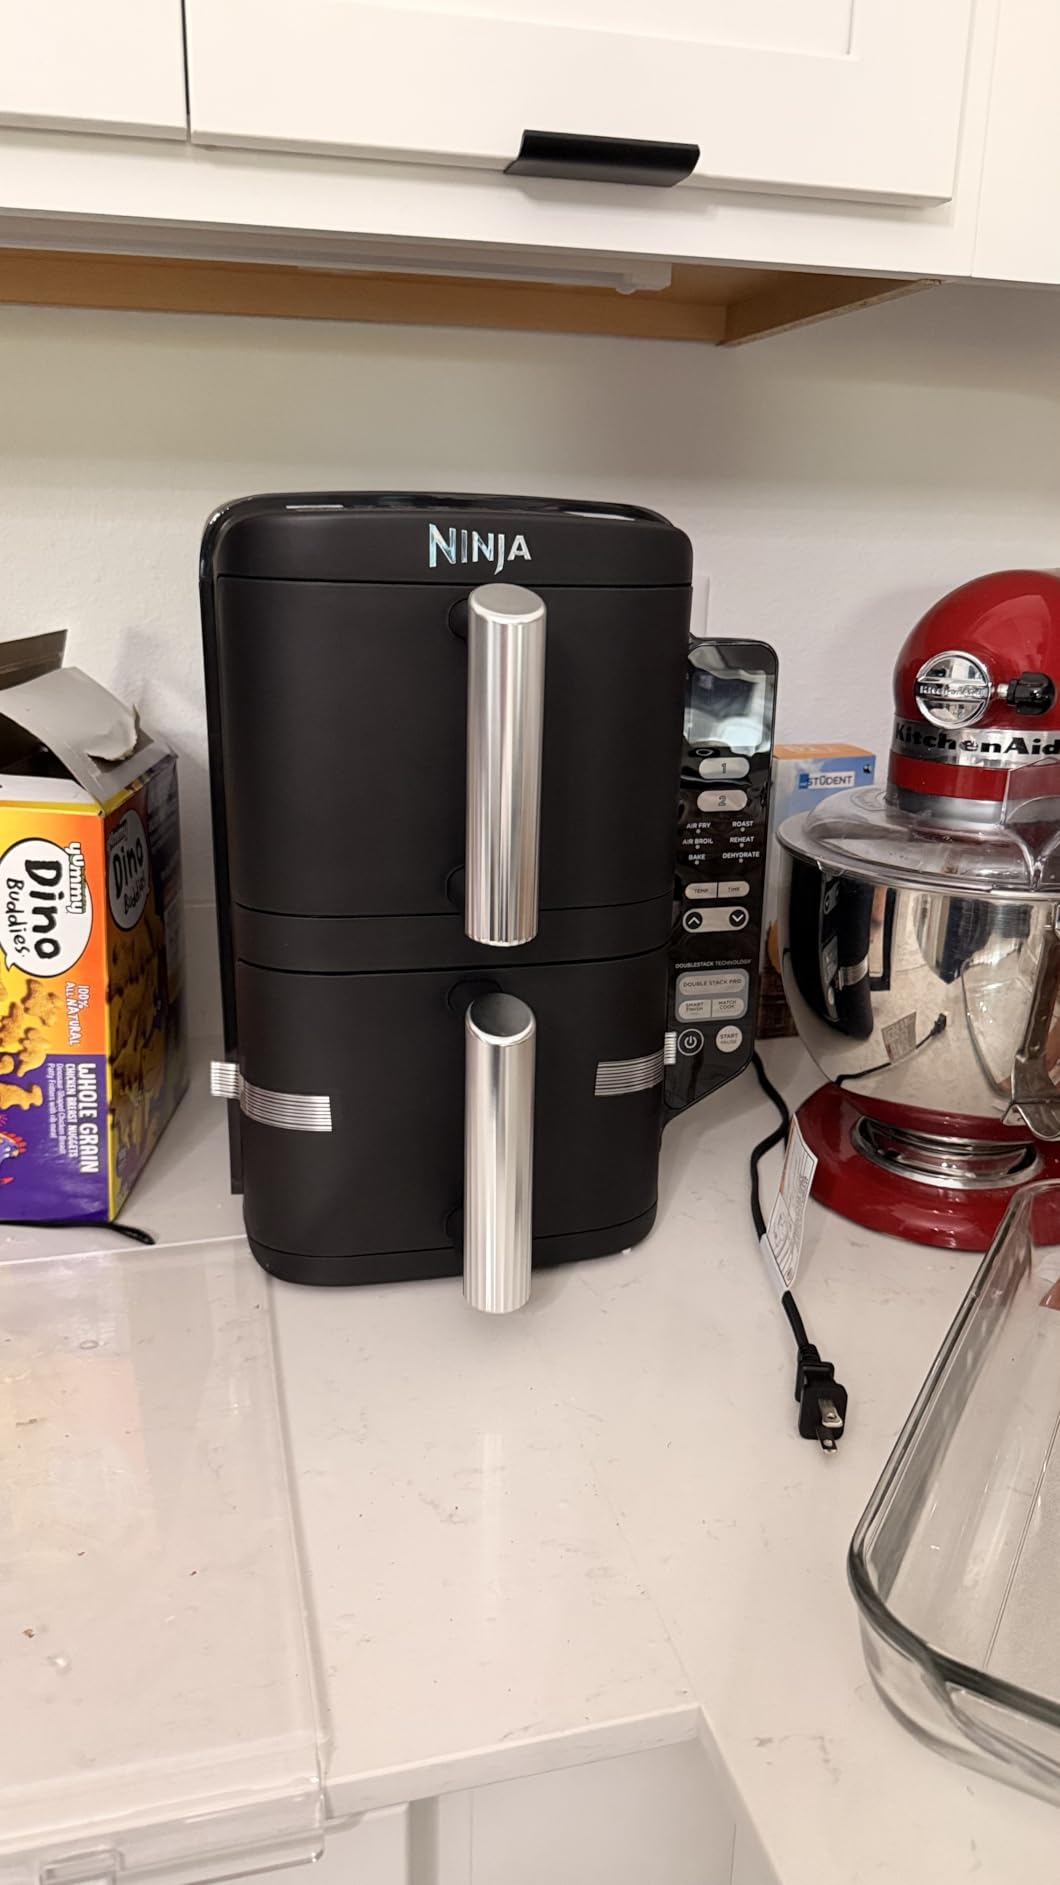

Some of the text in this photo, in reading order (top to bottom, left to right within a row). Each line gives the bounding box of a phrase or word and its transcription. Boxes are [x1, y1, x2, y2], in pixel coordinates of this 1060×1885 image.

[428, 523, 532, 575] NINJA
[895, 723, 1060, 755] KitchenAid
[721, 763, 727, 774] 1
[718, 795, 727, 807] 2
[65, 841, 86, 914] yummy
[113, 838, 144, 899] Dino
[722, 851, 760, 859] DEHYDRATE
[6, 877, 30, 955] Buddies
[25, 859, 64, 959] Dino
[675, 961, 714, 969] DOUBLESTACK
[66, 982, 81, 1045] ALL NATURAL
[78, 985, 90, 1009] 100%
[66, 1063, 78, 1158] CHICKEN BREAST NUGGETS
[78, 1063, 99, 1173] WHOLE GRAIN
